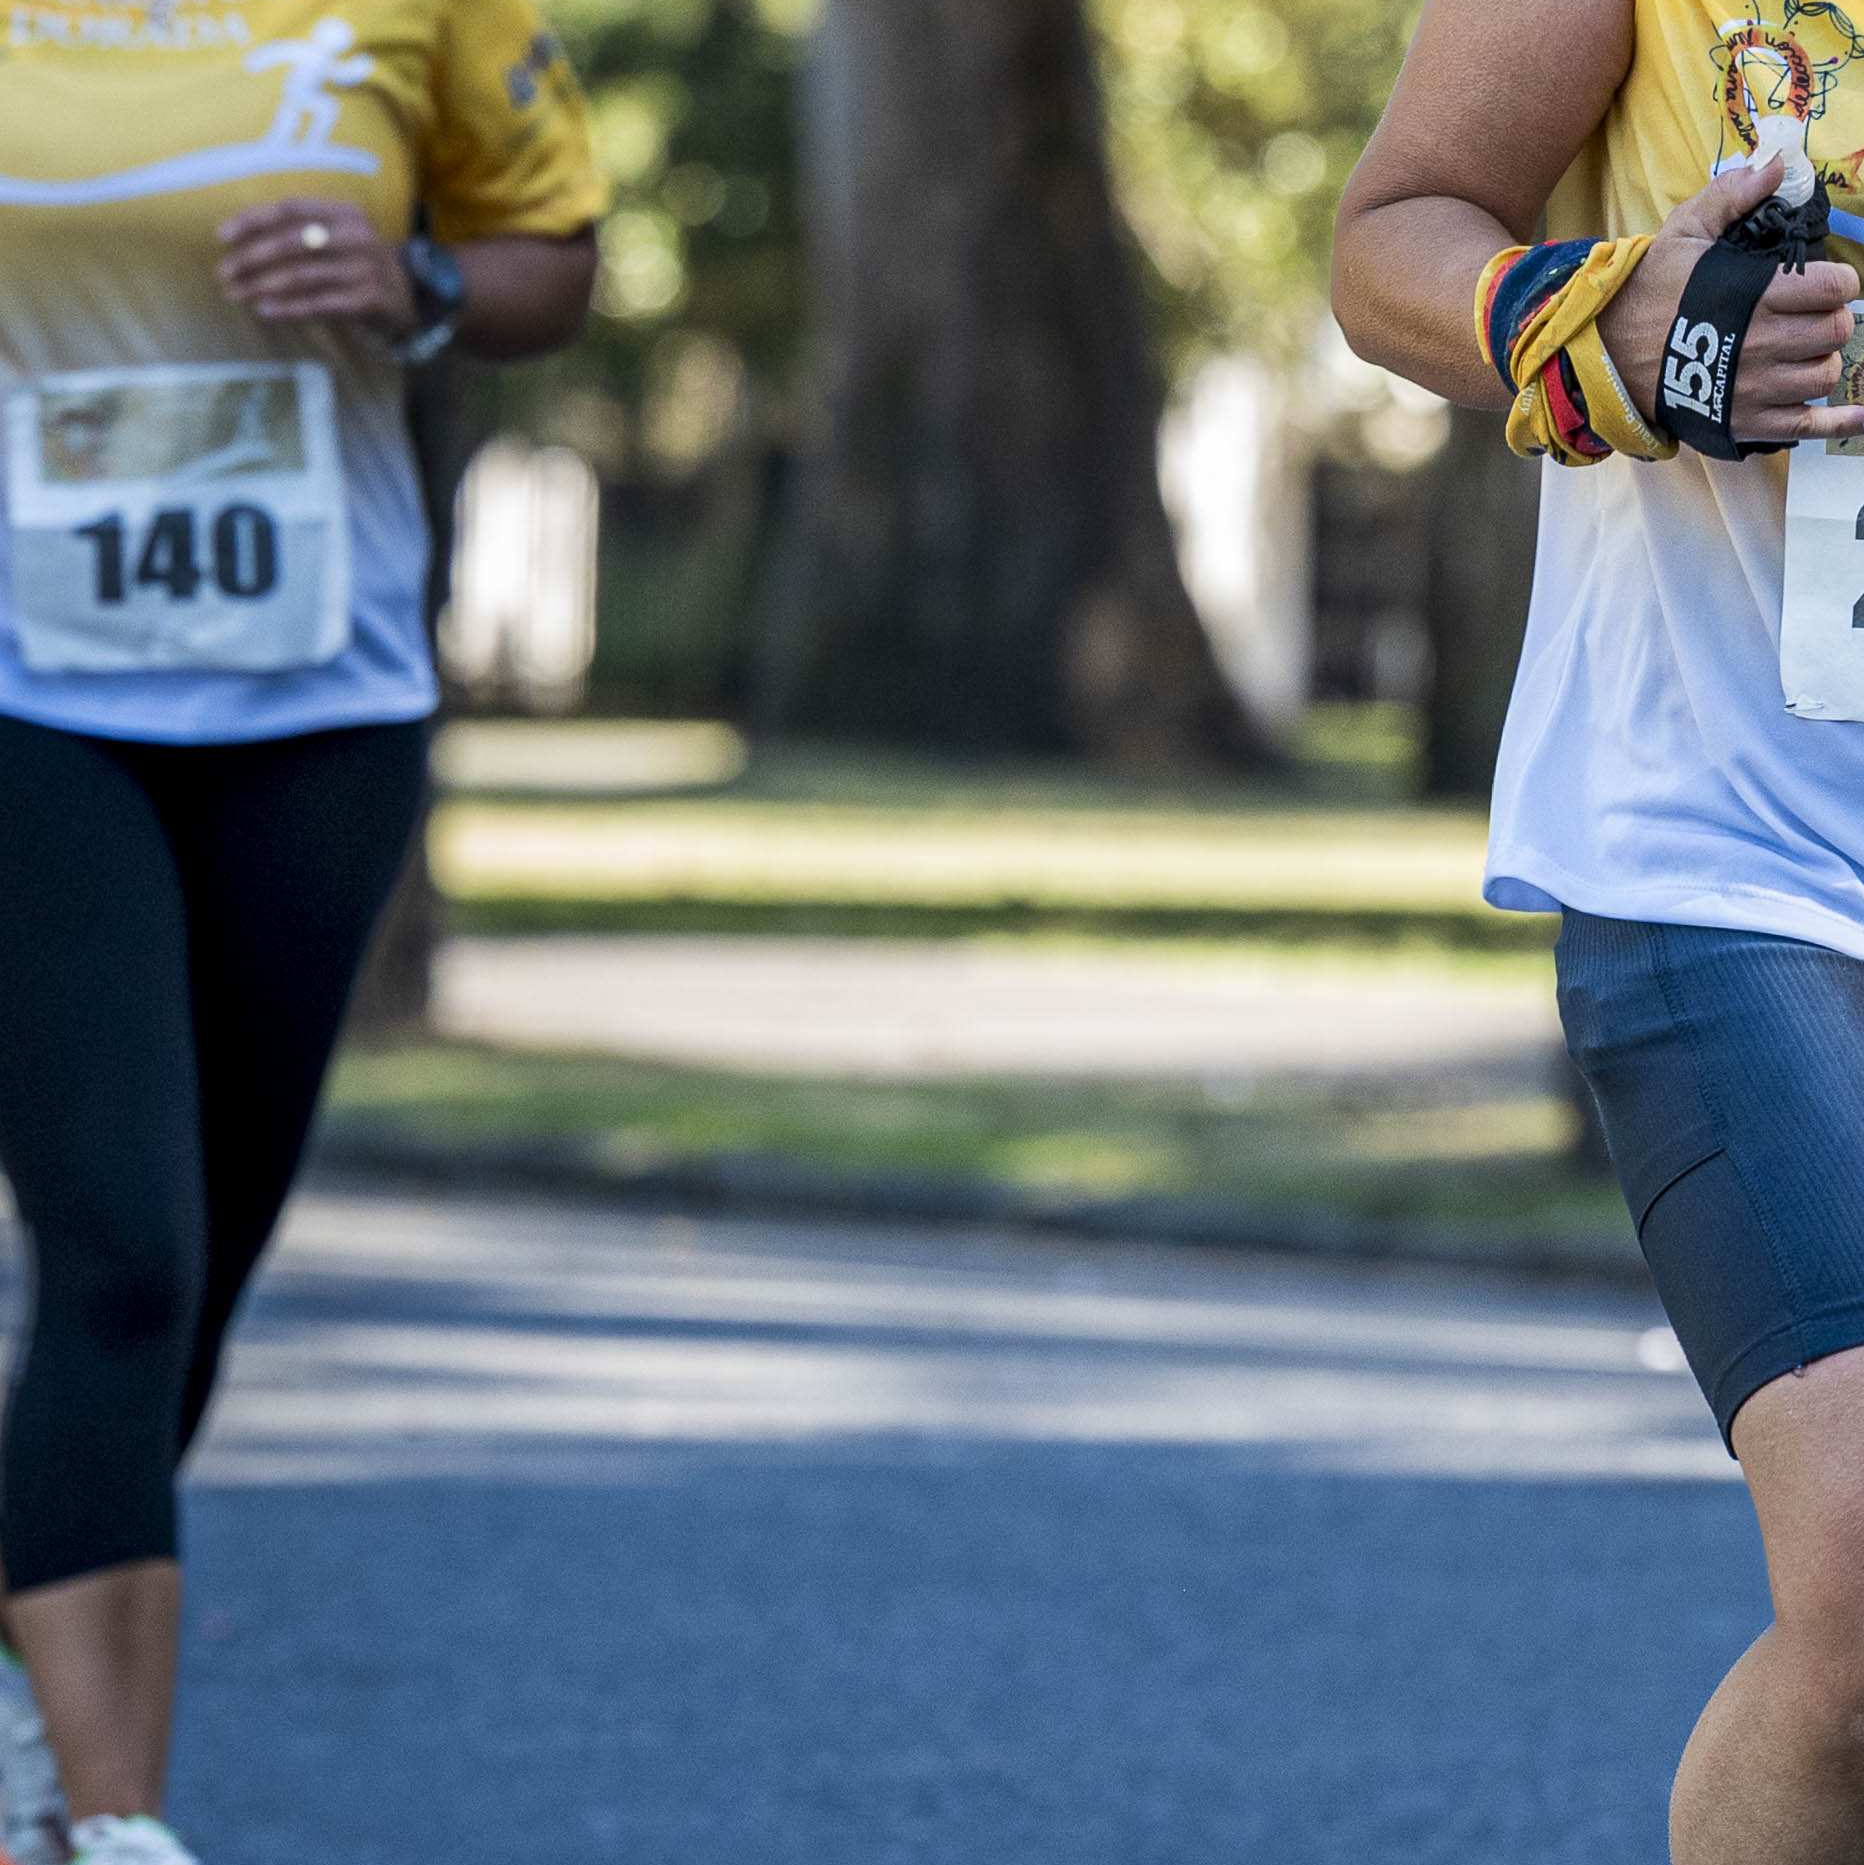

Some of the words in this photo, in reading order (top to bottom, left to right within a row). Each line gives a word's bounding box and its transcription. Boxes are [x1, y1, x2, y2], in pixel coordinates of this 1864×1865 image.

[1663, 316, 1719, 418] 155
[1714, 333, 1736, 399] CAPITAL
[76, 505, 278, 604] 140
